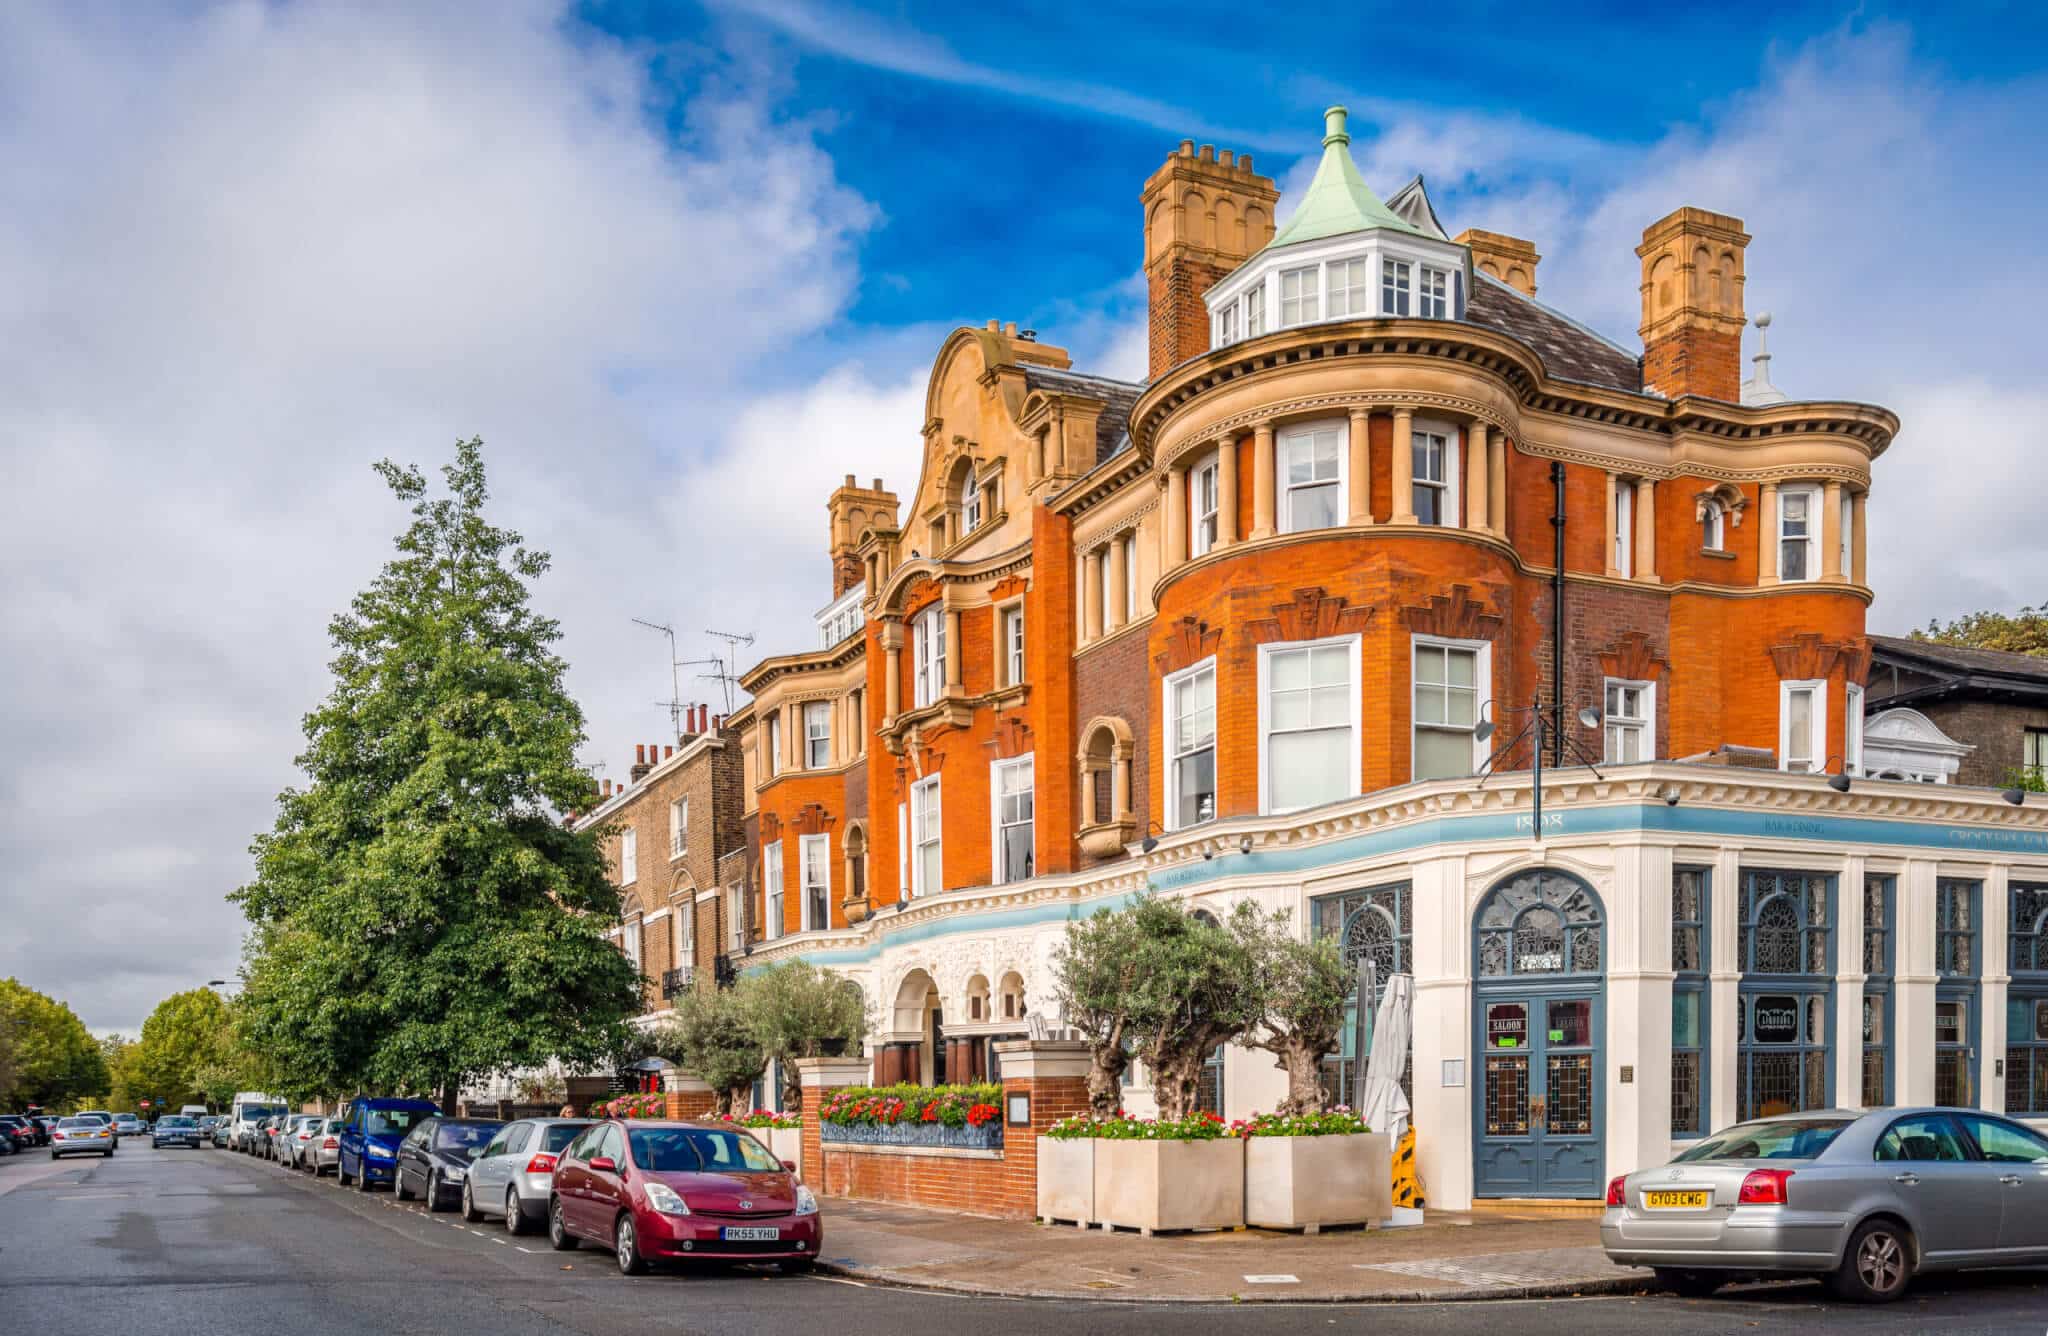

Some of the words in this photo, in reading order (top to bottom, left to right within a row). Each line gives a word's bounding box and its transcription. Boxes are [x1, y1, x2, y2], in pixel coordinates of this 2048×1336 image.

[1494, 1020, 1521, 1031] SALOON
[1651, 1192, 1678, 1205] GY03
[1680, 1192, 1702, 1205] CWG
[727, 1228, 754, 1239] RK55
[759, 1228, 777, 1239] YHU
